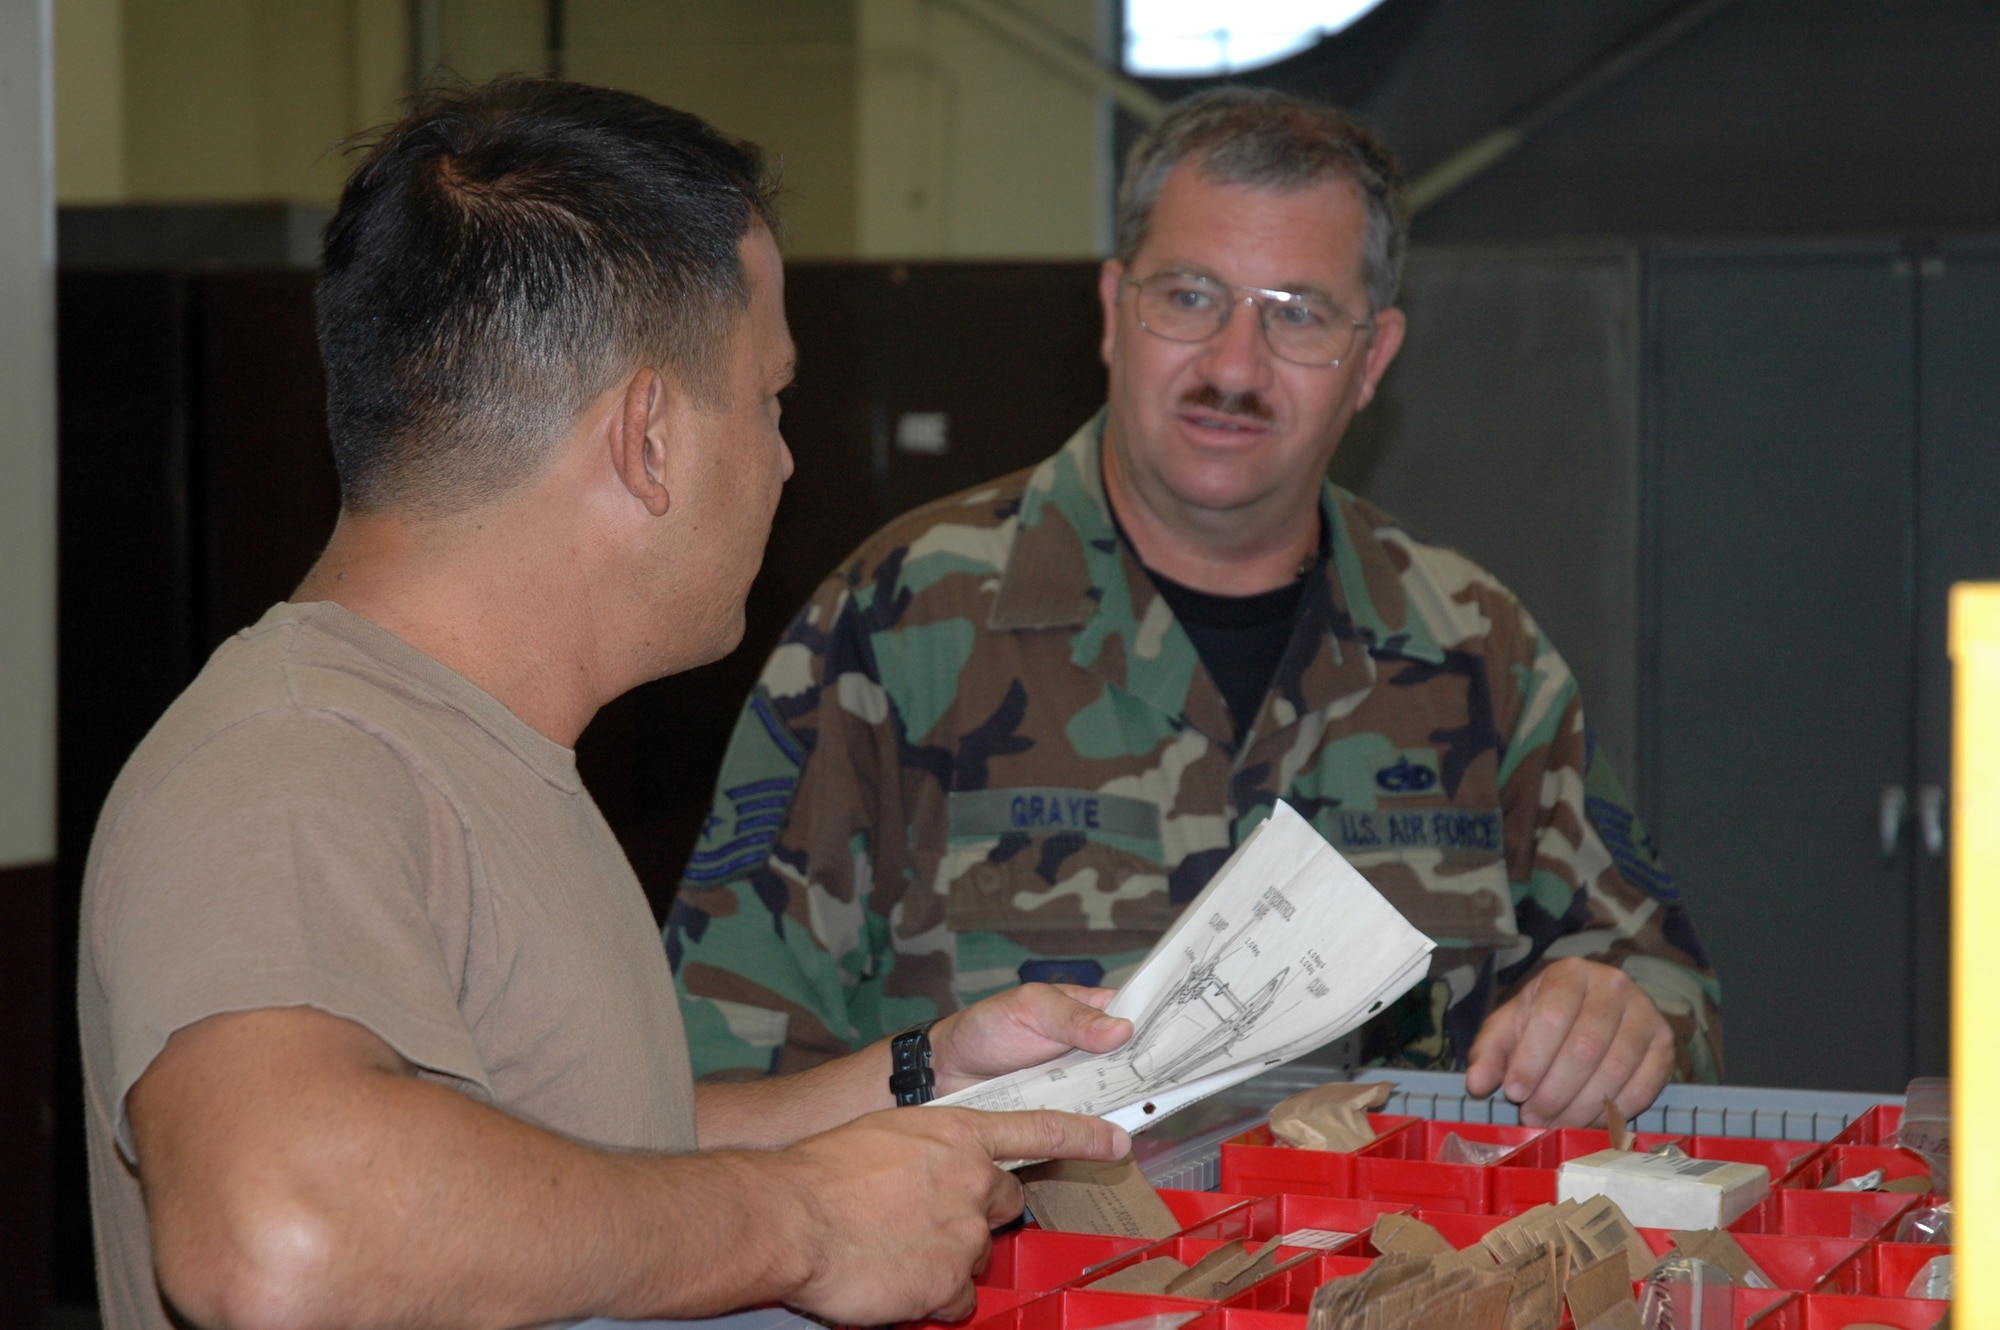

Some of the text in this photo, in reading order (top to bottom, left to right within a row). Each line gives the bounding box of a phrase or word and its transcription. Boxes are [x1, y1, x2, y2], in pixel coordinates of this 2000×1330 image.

[1010, 795, 1100, 829] GRAYE
[1341, 812, 1498, 849] U.S. AIR FORCE
